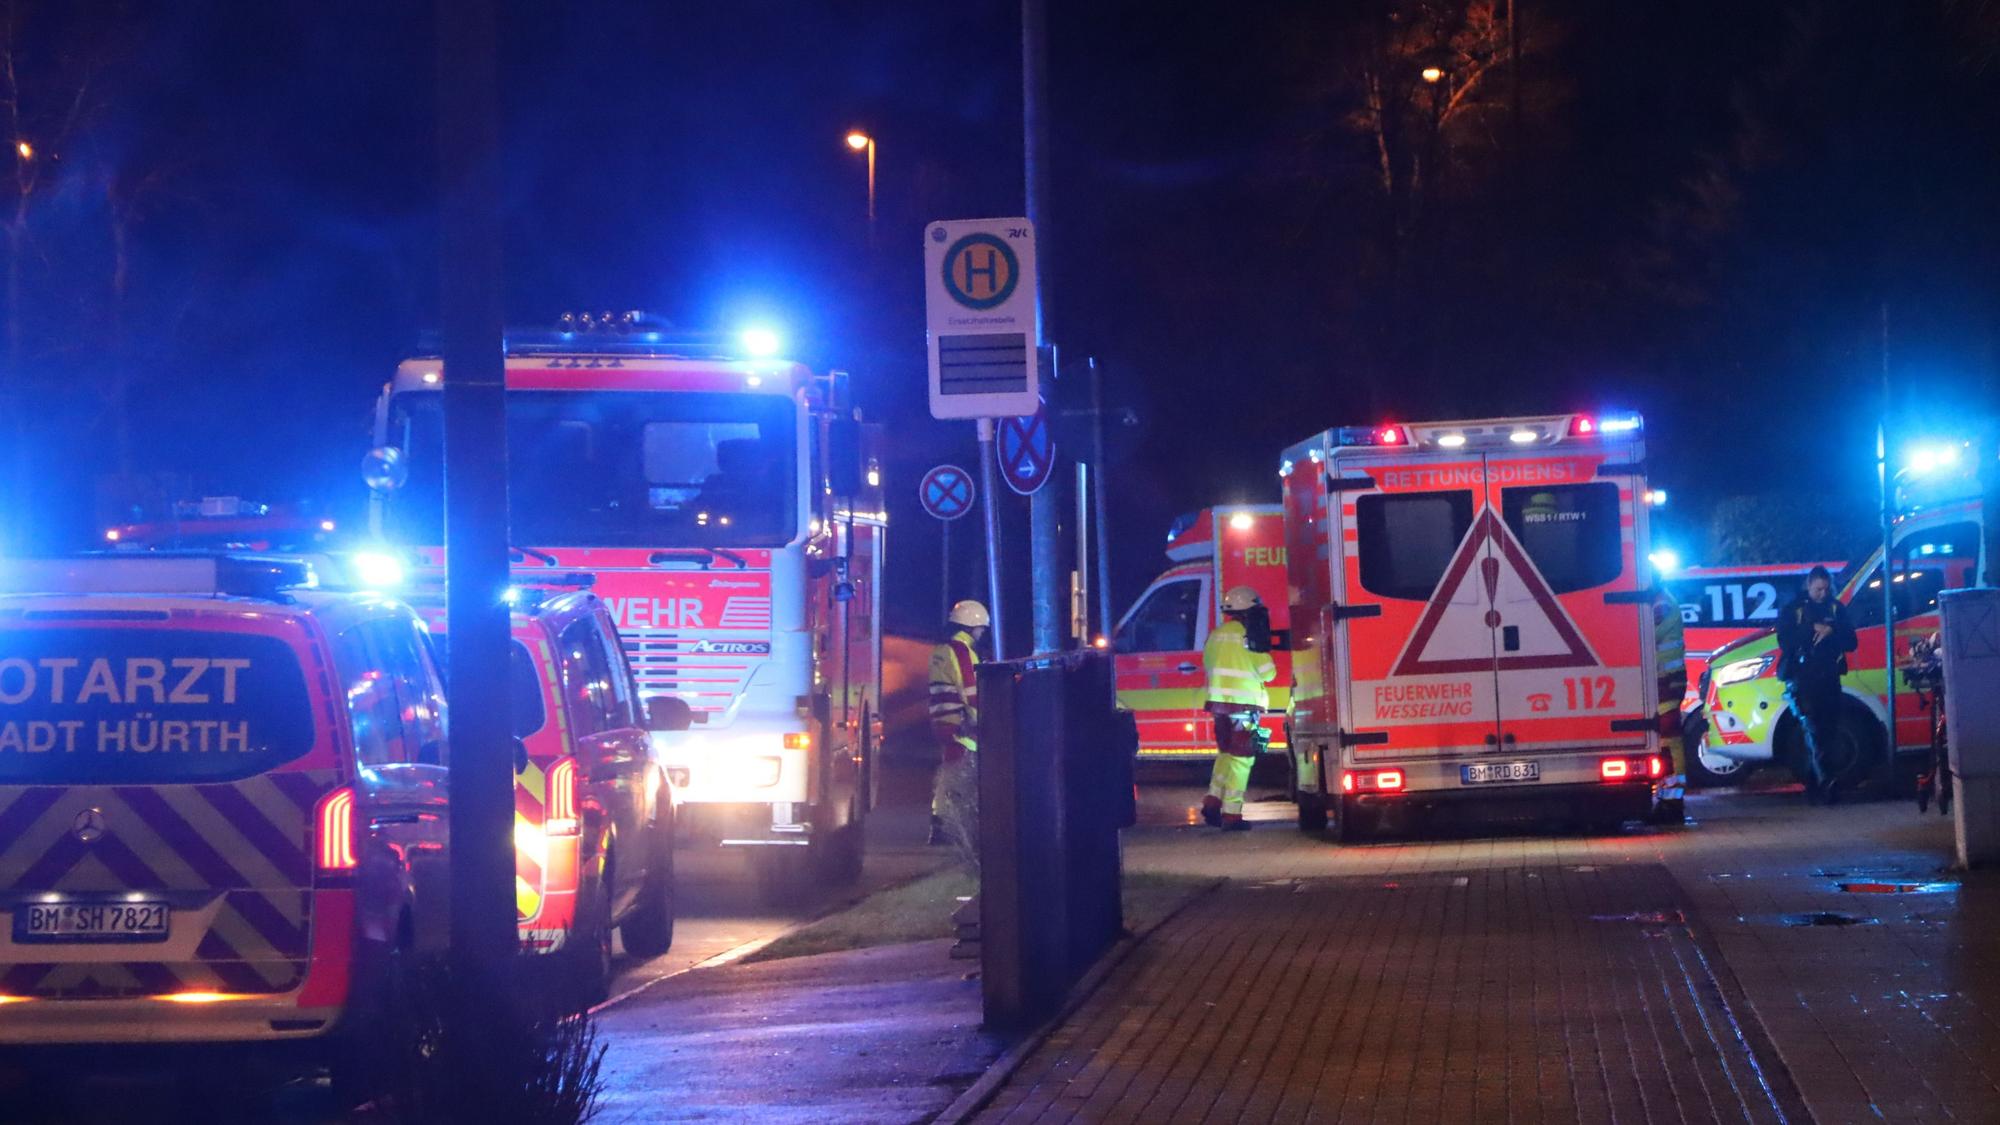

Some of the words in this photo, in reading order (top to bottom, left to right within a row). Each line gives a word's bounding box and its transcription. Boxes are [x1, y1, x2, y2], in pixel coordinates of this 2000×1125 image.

[965, 250, 996, 293] H
[1384, 462, 1577, 488] RETTUNGSDIENST
[1704, 582, 1778, 621] 112
[0, 657, 250, 704] OTARZT
[1375, 682, 1473, 704] FEUERWEHR
[1563, 675, 1616, 711] 112
[1375, 701, 1473, 720] WESSELING
[0, 720, 84, 752] ADT
[97, 712, 248, 752] HÜRTH
[1469, 766, 1487, 780] BM
[1494, 765, 1511, 778] RD
[1513, 764, 1537, 778] 831
[30, 907, 60, 930] BM
[76, 907, 104, 930] SH
[110, 907, 165, 930] 7821
